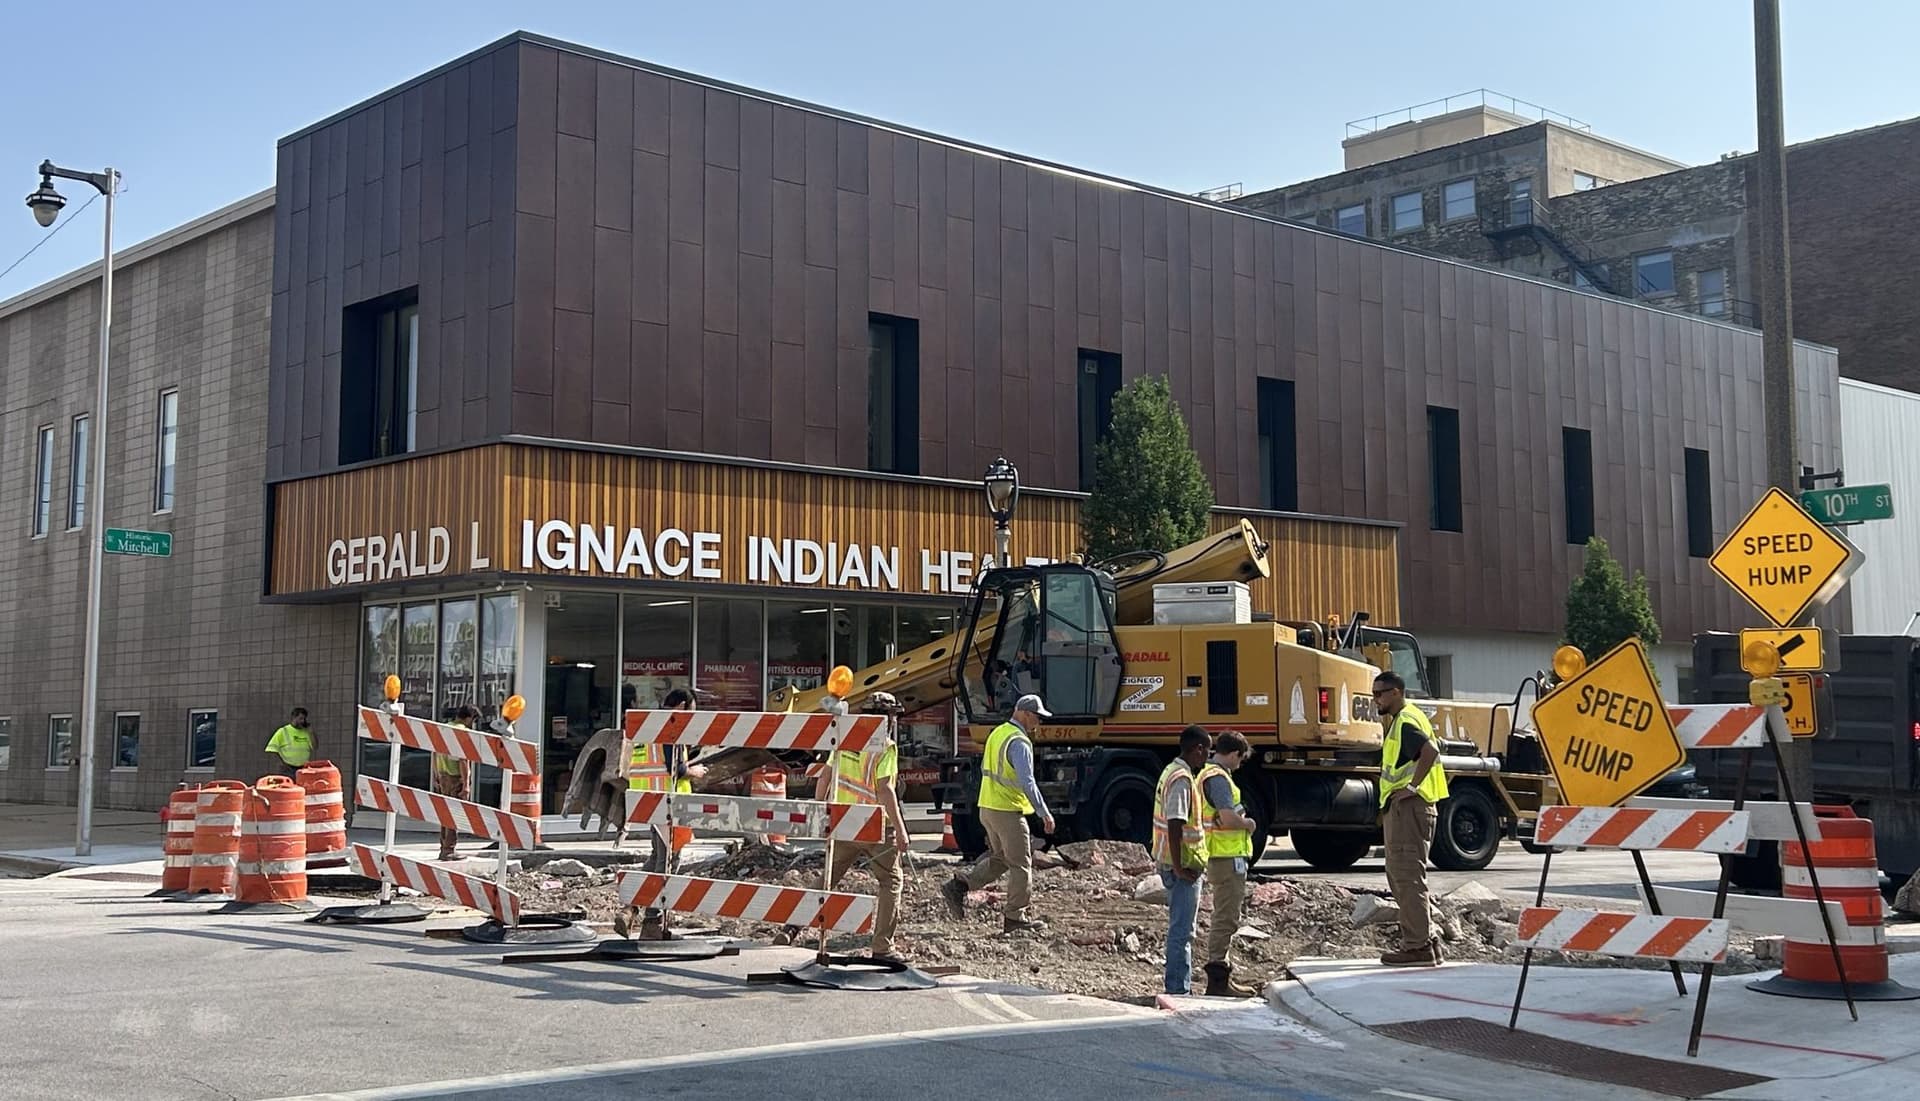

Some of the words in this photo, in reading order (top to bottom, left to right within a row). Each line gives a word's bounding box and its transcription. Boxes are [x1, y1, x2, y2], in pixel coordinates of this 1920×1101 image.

[1804, 500, 1813, 512] S
[1823, 493, 1859, 517] 10TH
[1875, 494, 1890, 508] ST
[118, 538, 160, 554] Mitchell
[327, 526, 451, 585] GERALD
[471, 521, 490, 569] L
[522, 519, 721, 578] IGNACE
[748, 535, 899, 589] INDIAN
[1743, 533, 1813, 555] SPEED
[1748, 565, 1812, 587] HUMP
[624, 662, 656, 671] MEDICAL
[656, 662, 684, 671] CLINIC
[1121, 651, 1171, 662] RADALL
[704, 664, 747, 673] PHARMACY
[768, 665, 796, 674] FITNESS
[796, 665, 823, 674] CENTER
[1577, 684, 1654, 732] SPEED
[1563, 735, 1634, 782] HUMP
